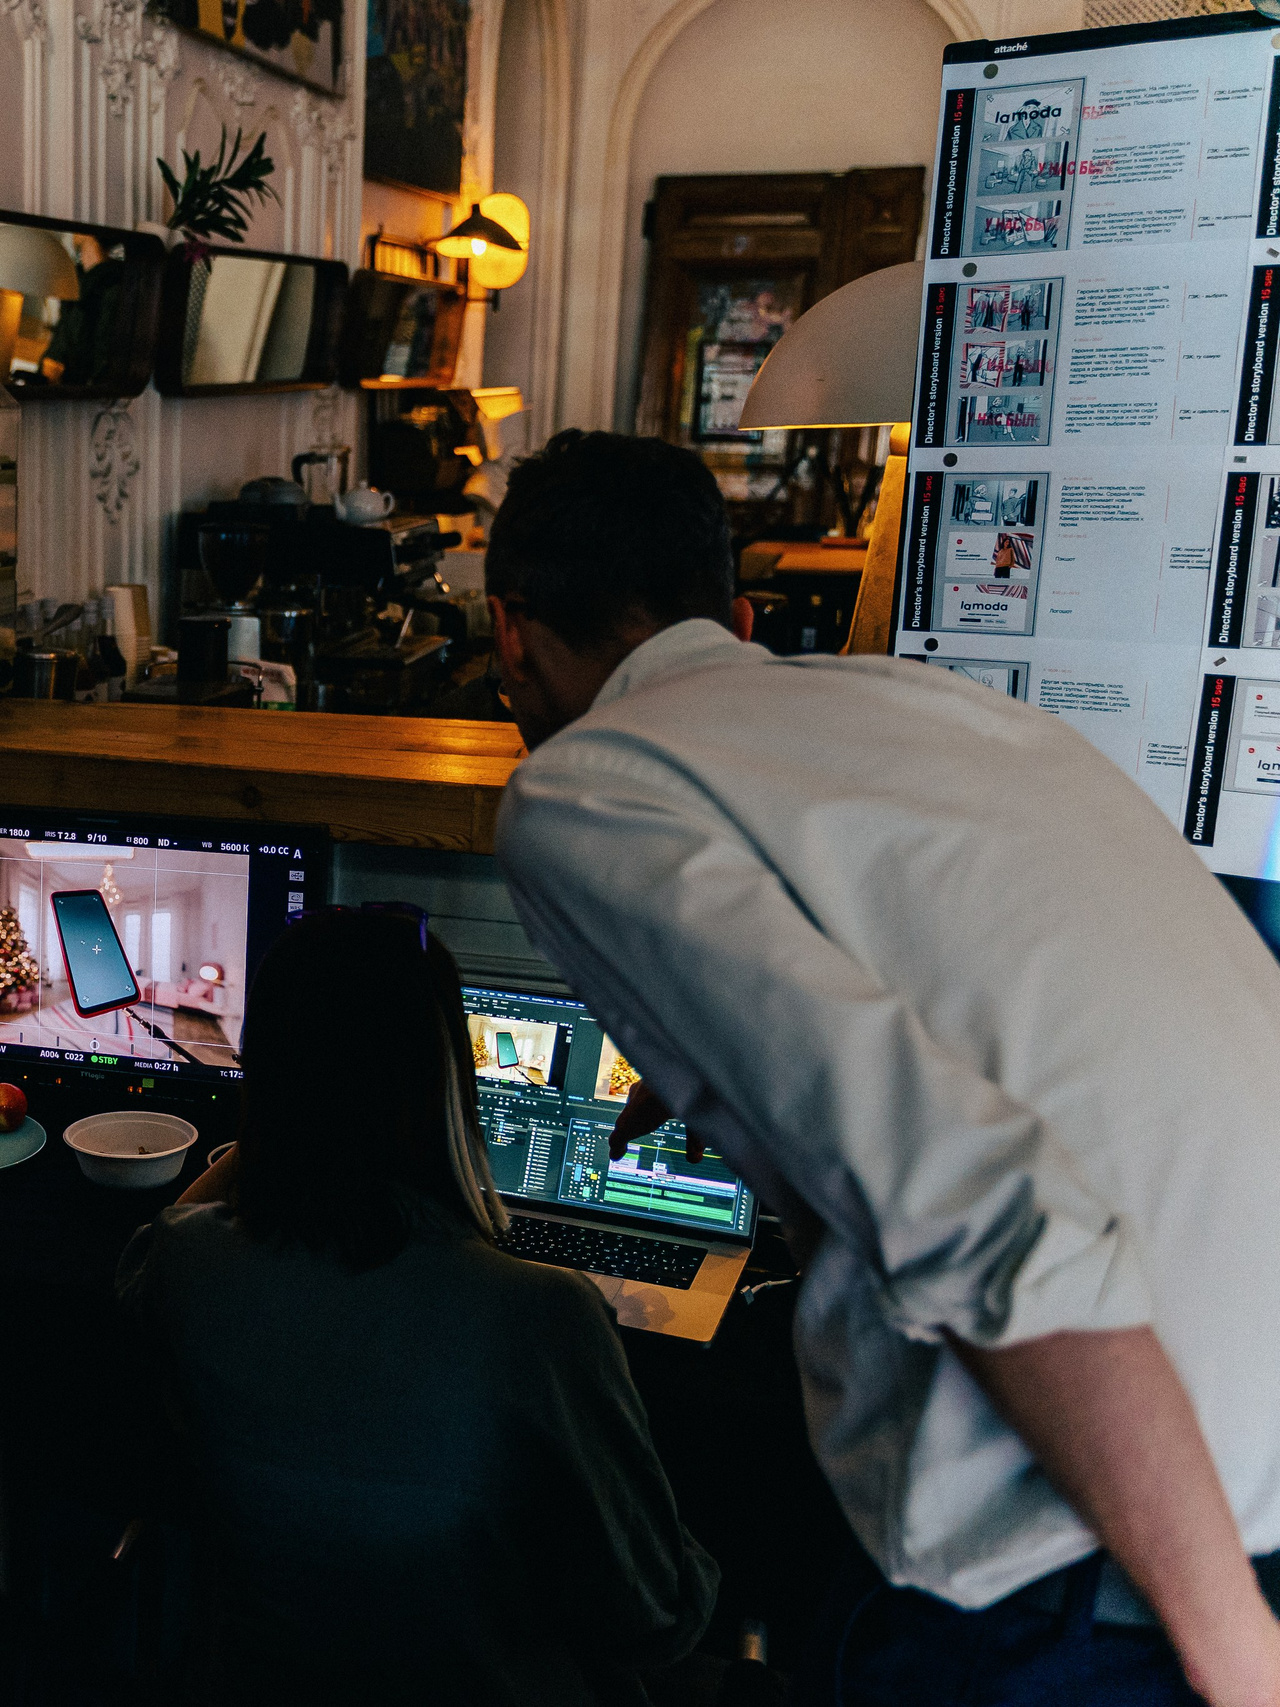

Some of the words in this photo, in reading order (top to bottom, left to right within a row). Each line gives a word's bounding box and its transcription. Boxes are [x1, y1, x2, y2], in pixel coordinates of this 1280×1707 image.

[993, 42, 1028, 54] attaché
[954, 112, 962, 121] 15
[994, 106, 1062, 124] lamoda
[951, 125, 961, 158] version
[946, 160, 957, 209] storyboard
[940, 211, 952, 254] Director's
[1261, 289, 1271, 299] 15
[1265, 270, 1273, 286] sec
[936, 305, 943, 314] 15
[1258, 303, 1269, 339] version
[934, 318, 943, 350] version
[929, 352, 939, 399] storyboard
[1251, 340, 1265, 393] storyboard
[925, 402, 936, 444] Director's
[1244, 395, 1259, 441] Director's
[923, 493, 930, 501] 15
[1235, 496, 1244, 505] 15
[1238, 477, 1247, 493] sec
[921, 505, 930, 536] version
[1232, 509, 1243, 543] version
[916, 539, 926, 584] storyboard
[1225, 545, 1239, 596] storyboard
[912, 587, 922, 627] Director's
[960, 601, 1008, 611] lamoda
[1219, 598, 1233, 643] Director's
[1211, 697, 1221, 707] 15
[1215, 679, 1223, 695] sec
[1207, 710, 1219, 744] version
[1200, 745, 1214, 795] storyboard
[1193, 797, 1207, 840] Director's
[9, 828, 30, 837] 180.0
[87, 834, 107, 843] 9/10
[133, 837, 149, 845] 800
[158, 838, 170, 847] ND
[202, 841, 213, 849] WB
[220, 843, 241, 852] 5600
[243, 844, 250, 852] K
[258, 846, 276, 854] +0.0
[278, 847, 289, 855] CC
[293, 849, 302, 859] A
[40, 1050, 59, 1059] A004
[64, 1053, 84, 1062] C022
[98, 1055, 119, 1065] STBY
[134, 1061, 153, 1069] MEDIA
[154, 1062, 171, 1071] 0:27
[173, 1063, 179, 1072] h
[220, 1070, 228, 1078] TC
